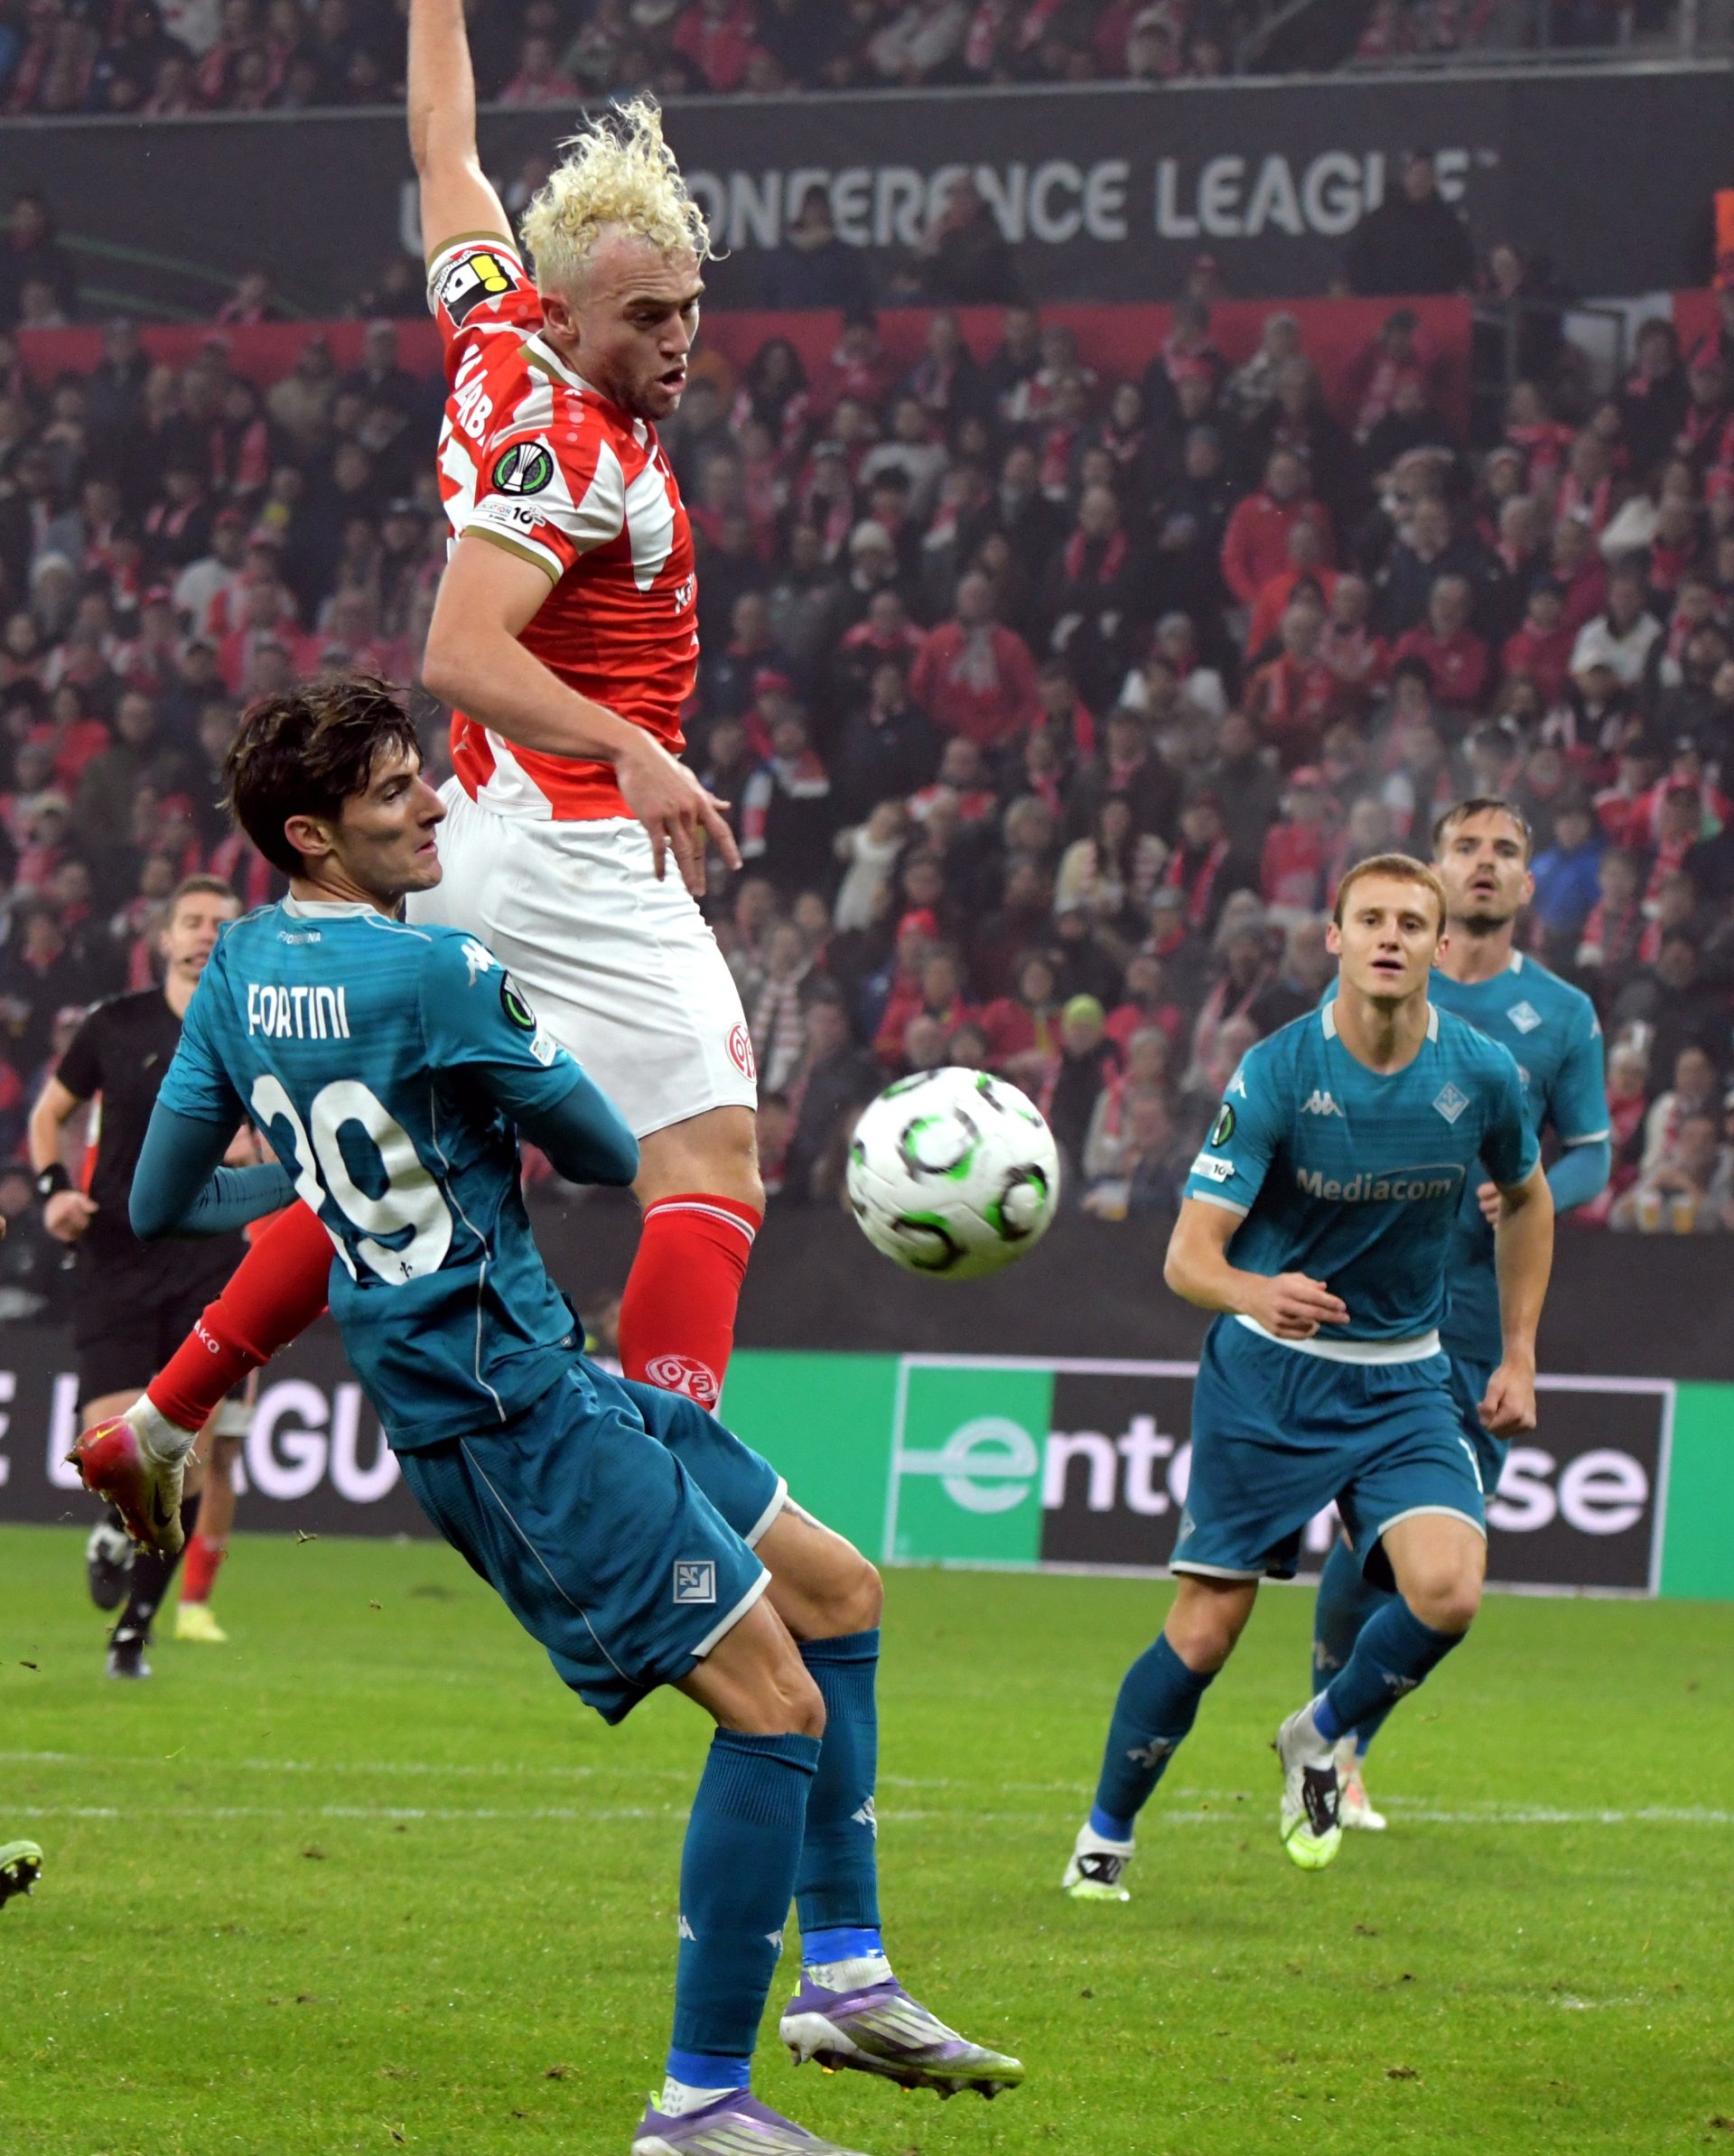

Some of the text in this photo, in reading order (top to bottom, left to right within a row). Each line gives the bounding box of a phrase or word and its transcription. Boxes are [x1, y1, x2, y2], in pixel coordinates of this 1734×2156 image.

[682, 146, 1469, 250] ONFERENCE LEAGE
[247, 984, 350, 1039] FORTINI
[1296, 1168, 1452, 1202] Mediacom
[193, 1319, 220, 1354] AKO
